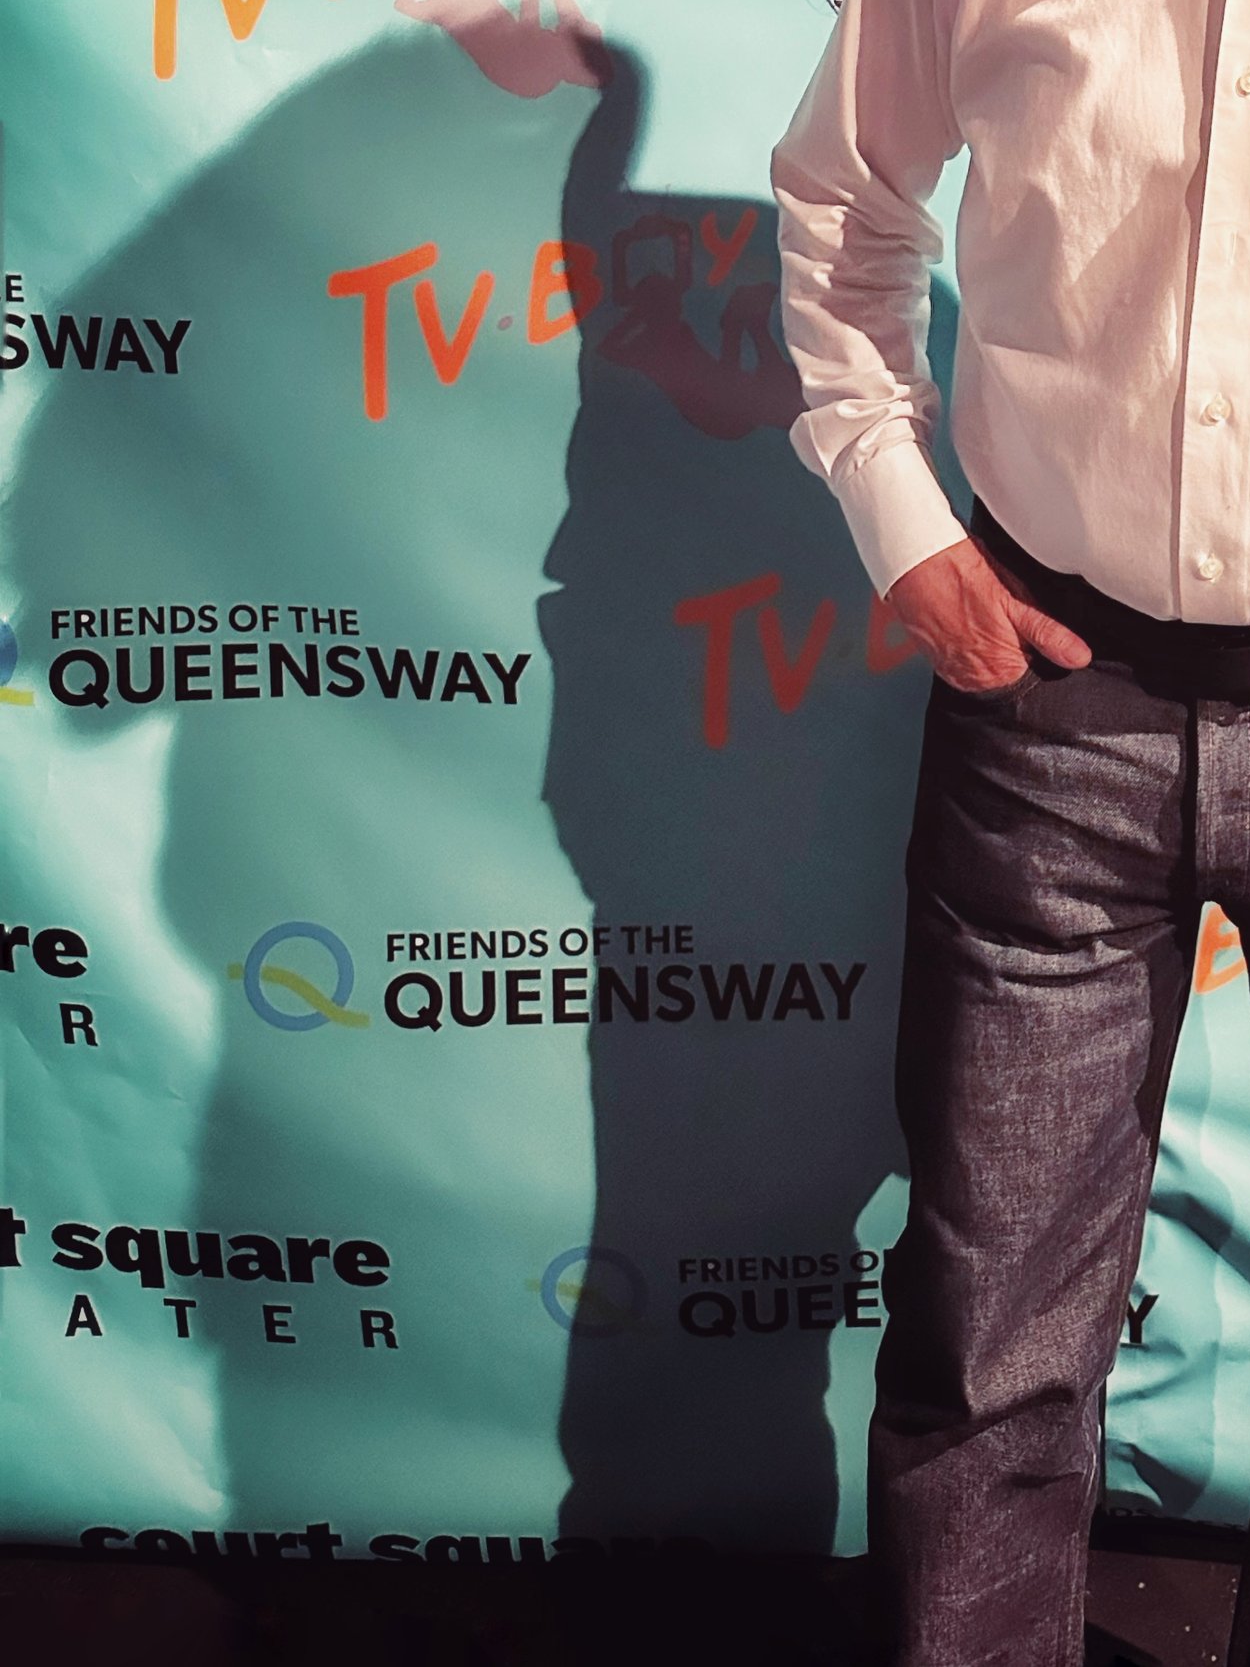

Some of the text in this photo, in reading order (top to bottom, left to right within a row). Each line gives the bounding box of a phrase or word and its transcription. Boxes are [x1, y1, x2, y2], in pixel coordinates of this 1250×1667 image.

[50, 604, 361, 640] FRIENDS OF THE
[48, 642, 532, 710] QUEENSWAY
[386, 925, 694, 962] FRIENDS OF THE
[384, 962, 867, 1032] QUEENSWAY
[51, 1223, 390, 1288] square
[679, 1250, 878, 1282] FRIENDS O
